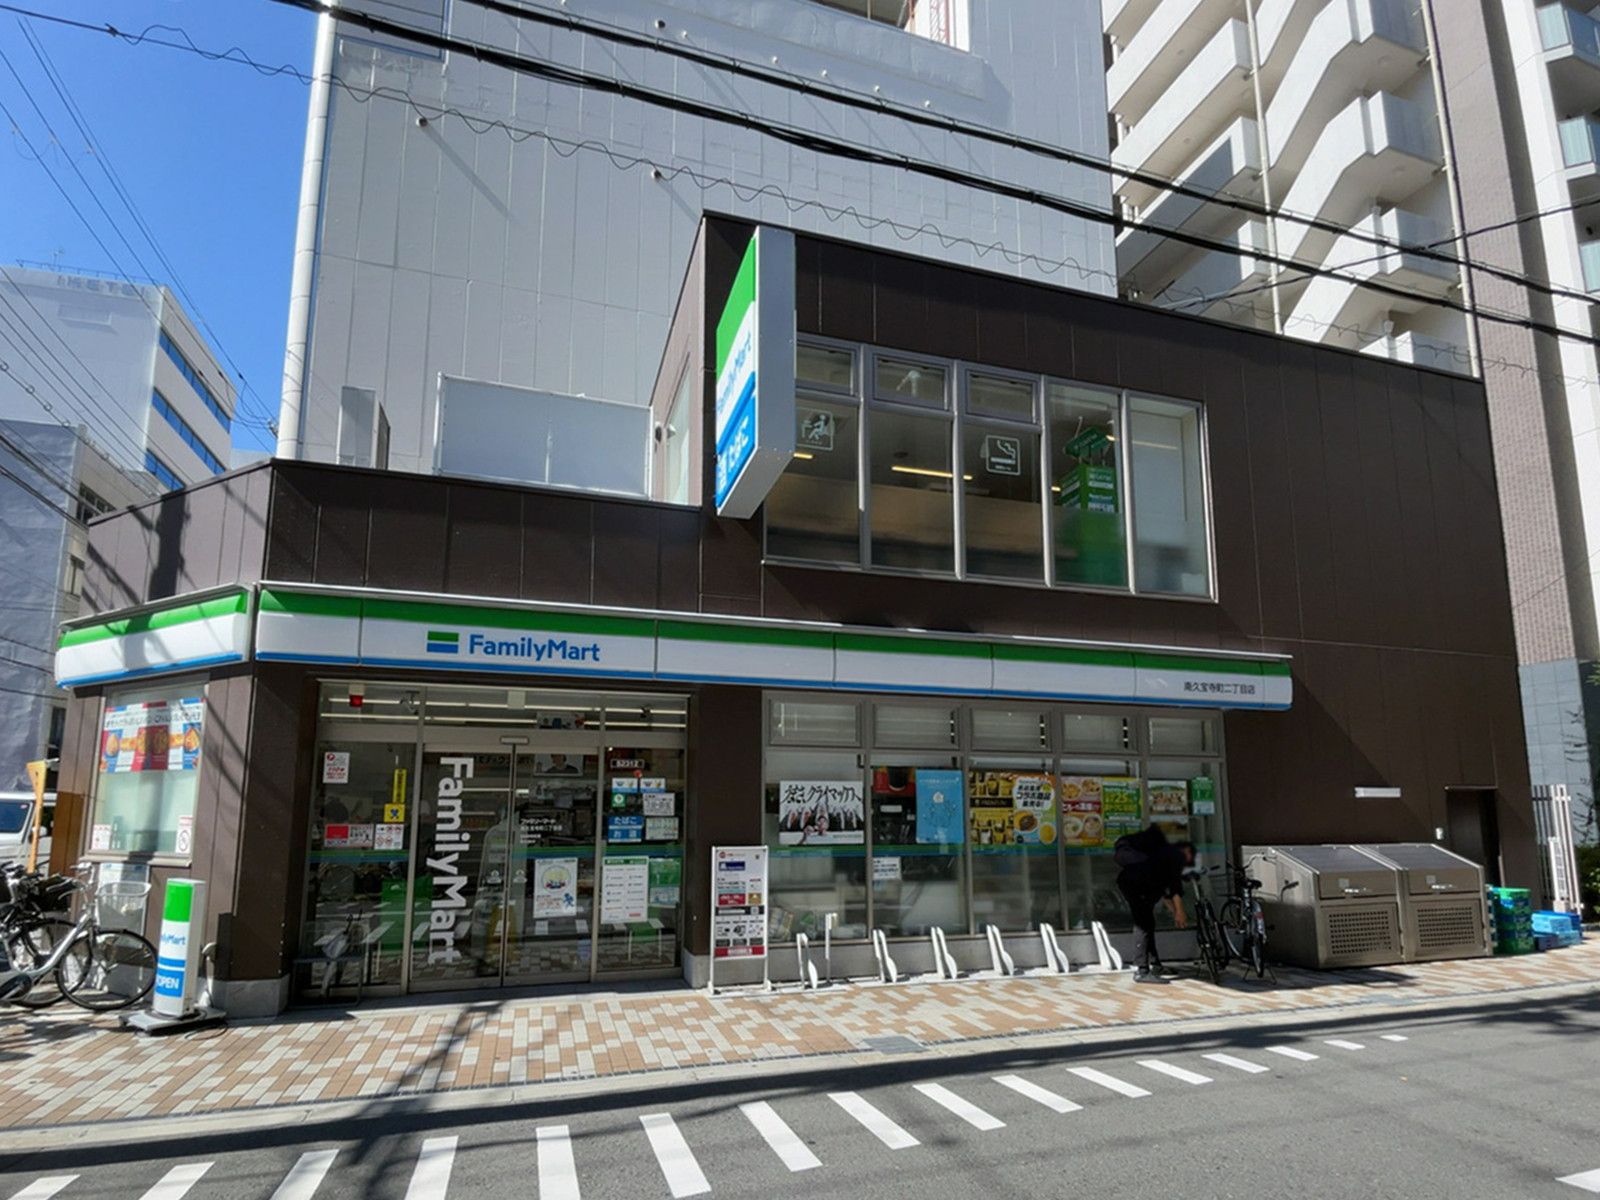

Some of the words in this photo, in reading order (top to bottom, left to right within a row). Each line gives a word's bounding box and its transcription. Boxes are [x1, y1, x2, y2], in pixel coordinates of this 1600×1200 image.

[469, 633, 600, 662] FamilyMart
[614, 816, 638, 825] たばこ
[426, 756, 474, 965] FamilyMart
